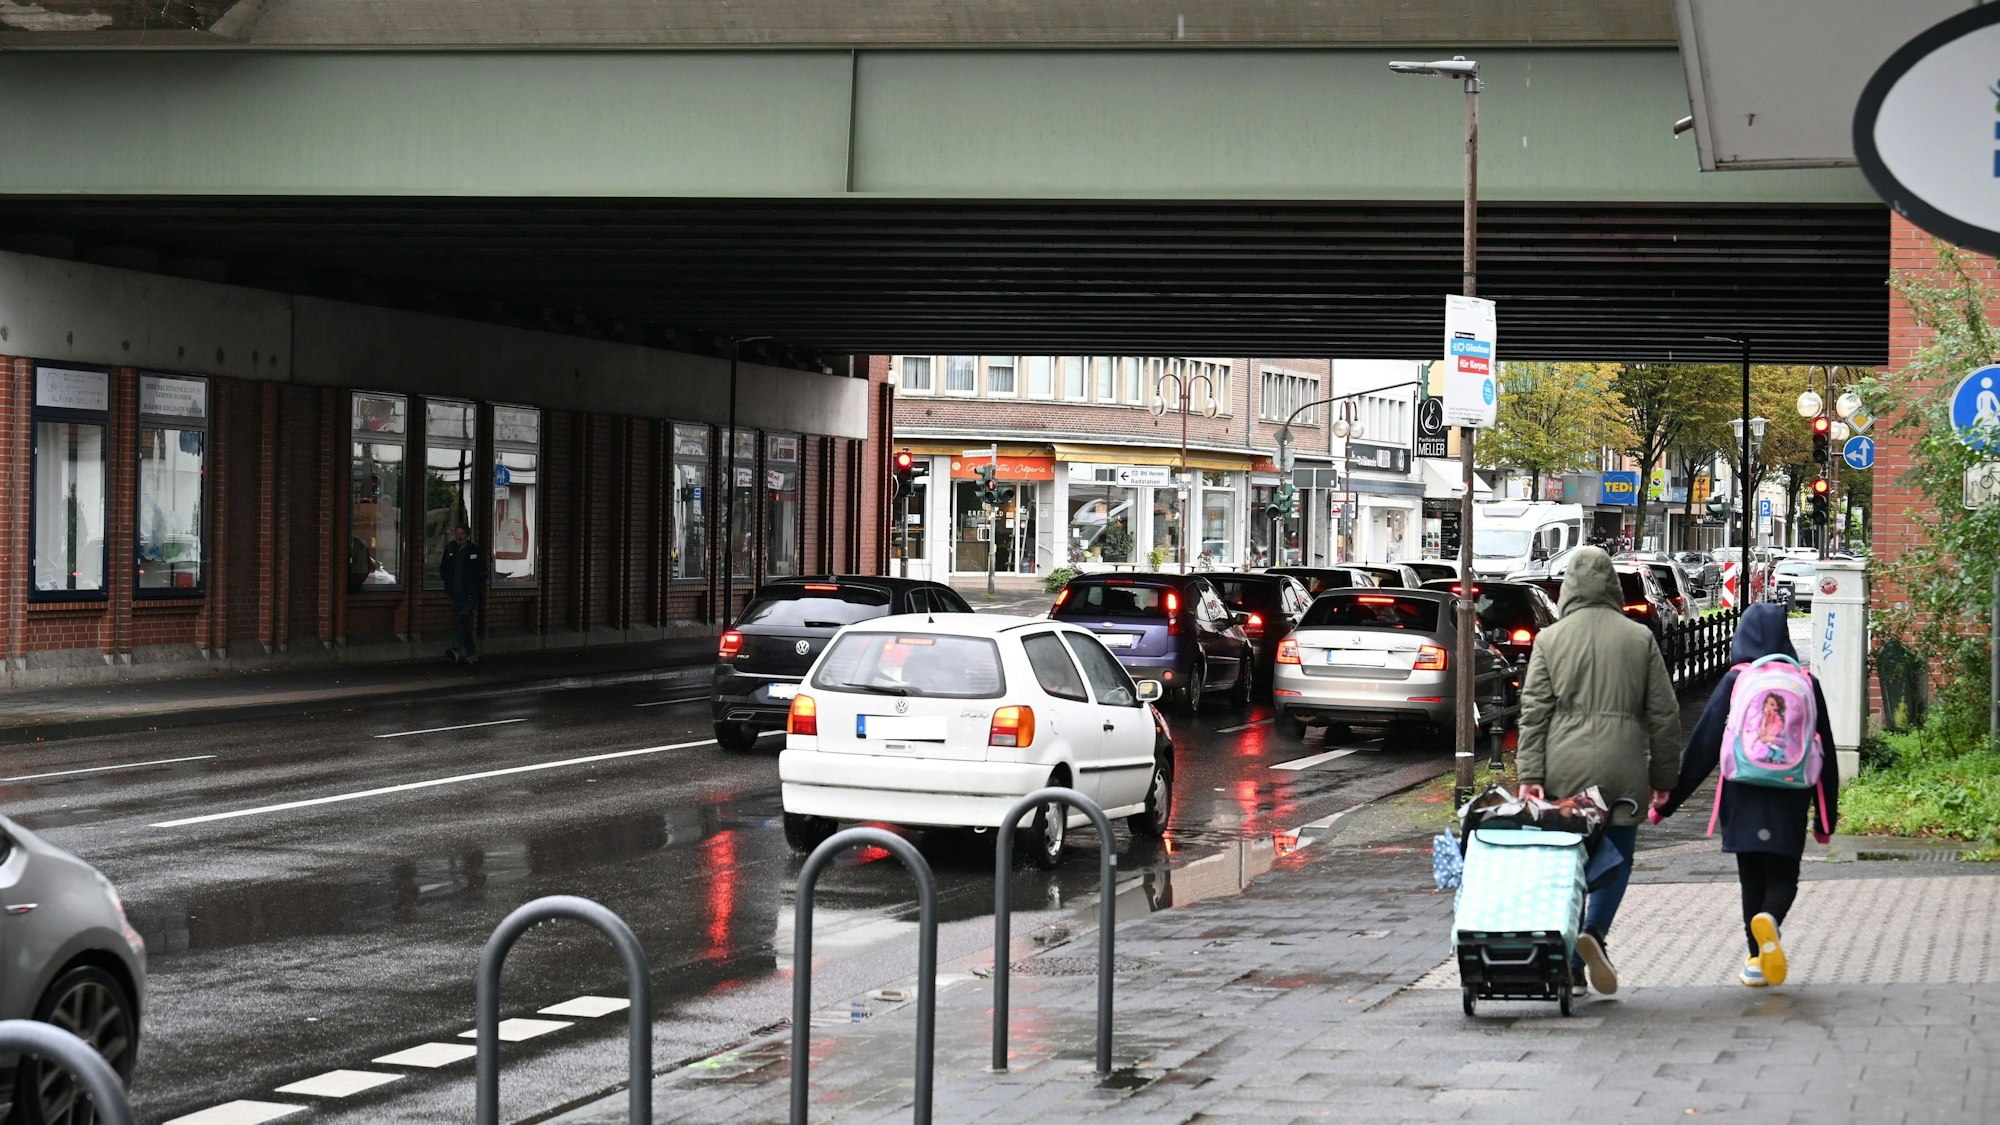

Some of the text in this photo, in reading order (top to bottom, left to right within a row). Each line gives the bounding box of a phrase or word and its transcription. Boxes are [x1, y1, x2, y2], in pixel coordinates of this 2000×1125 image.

[1418, 443, 1445, 456] MELLER
[1604, 482, 1632, 492] TEDi
[967, 510, 1004, 518] ERFTGLD
